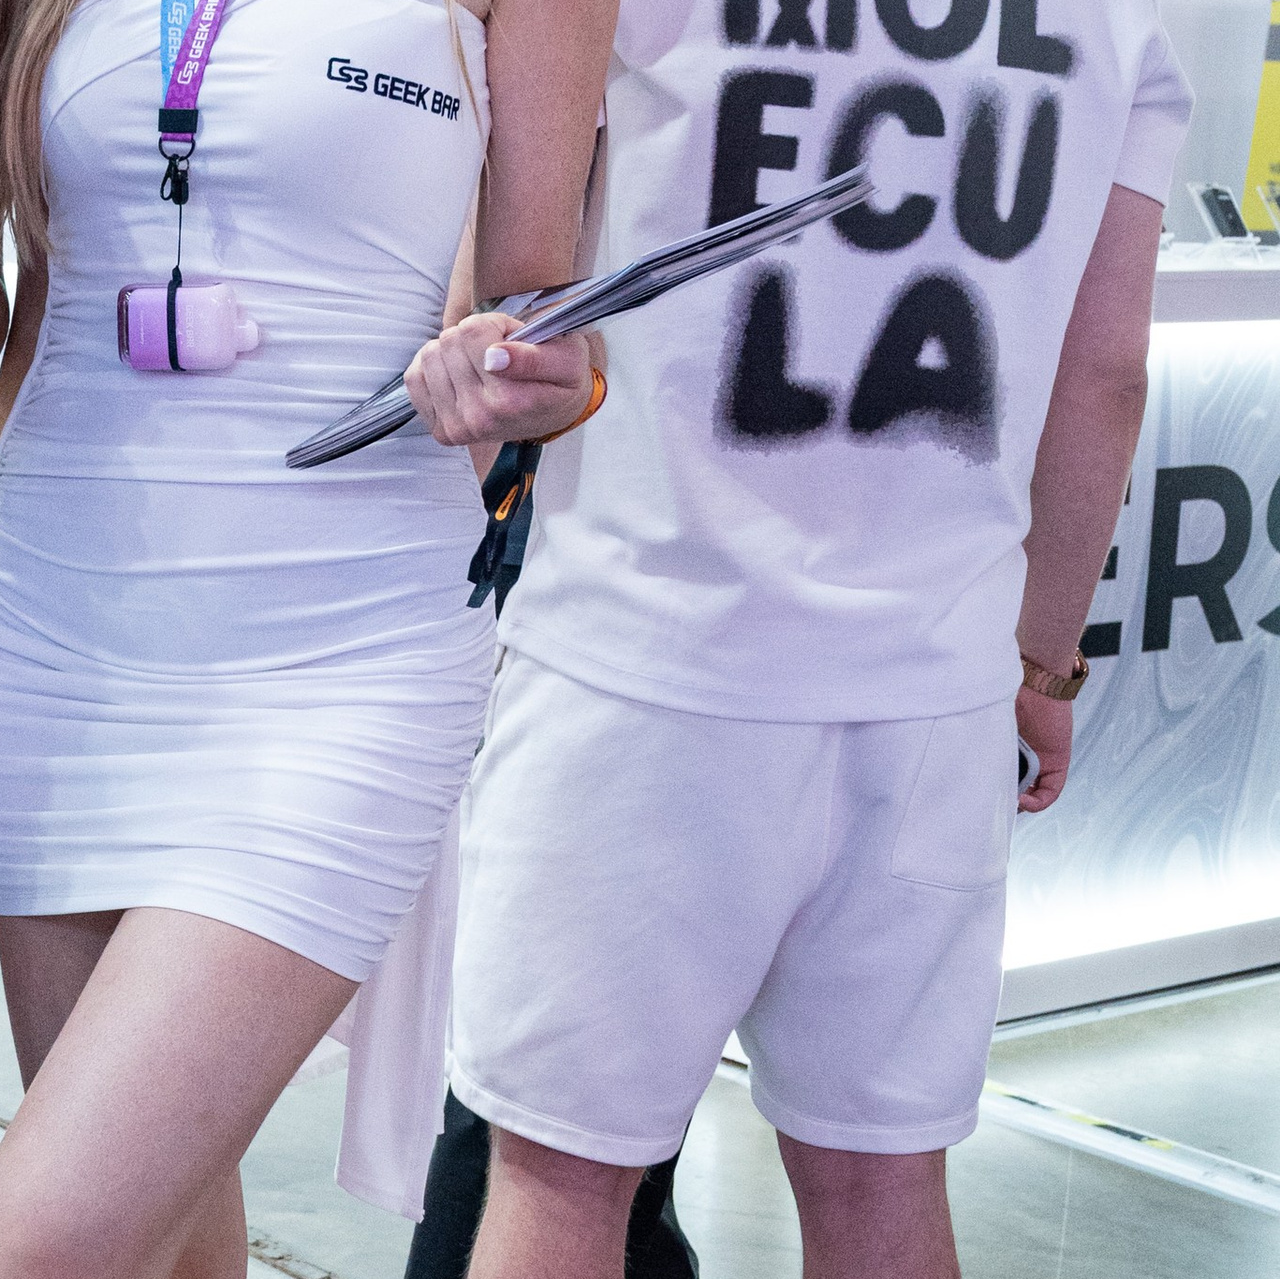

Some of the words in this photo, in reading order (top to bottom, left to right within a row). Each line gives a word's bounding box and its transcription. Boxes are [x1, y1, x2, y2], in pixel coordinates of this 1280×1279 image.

[189, 22, 211, 59] GEEK
[373, 73, 430, 111] GEEK
[431, 90, 460, 122] BAR
[706, 64, 1061, 263] ECU
[715, 260, 1002, 458] LA
